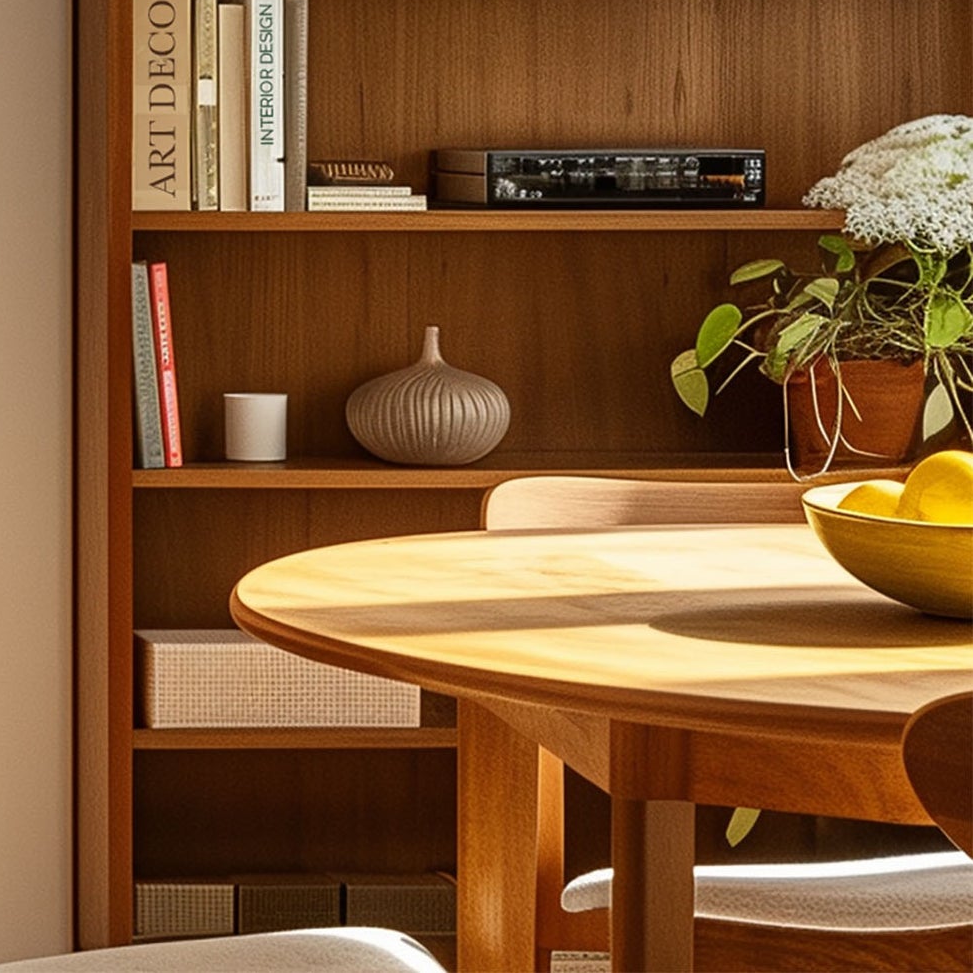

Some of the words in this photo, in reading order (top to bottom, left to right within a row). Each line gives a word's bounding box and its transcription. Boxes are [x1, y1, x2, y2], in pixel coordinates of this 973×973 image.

[147, 0, 176, 111] DECO
[259, 3, 274, 64] DESIGN
[259, 68, 274, 146] INTERIOR
[148, 119, 176, 198] ART
